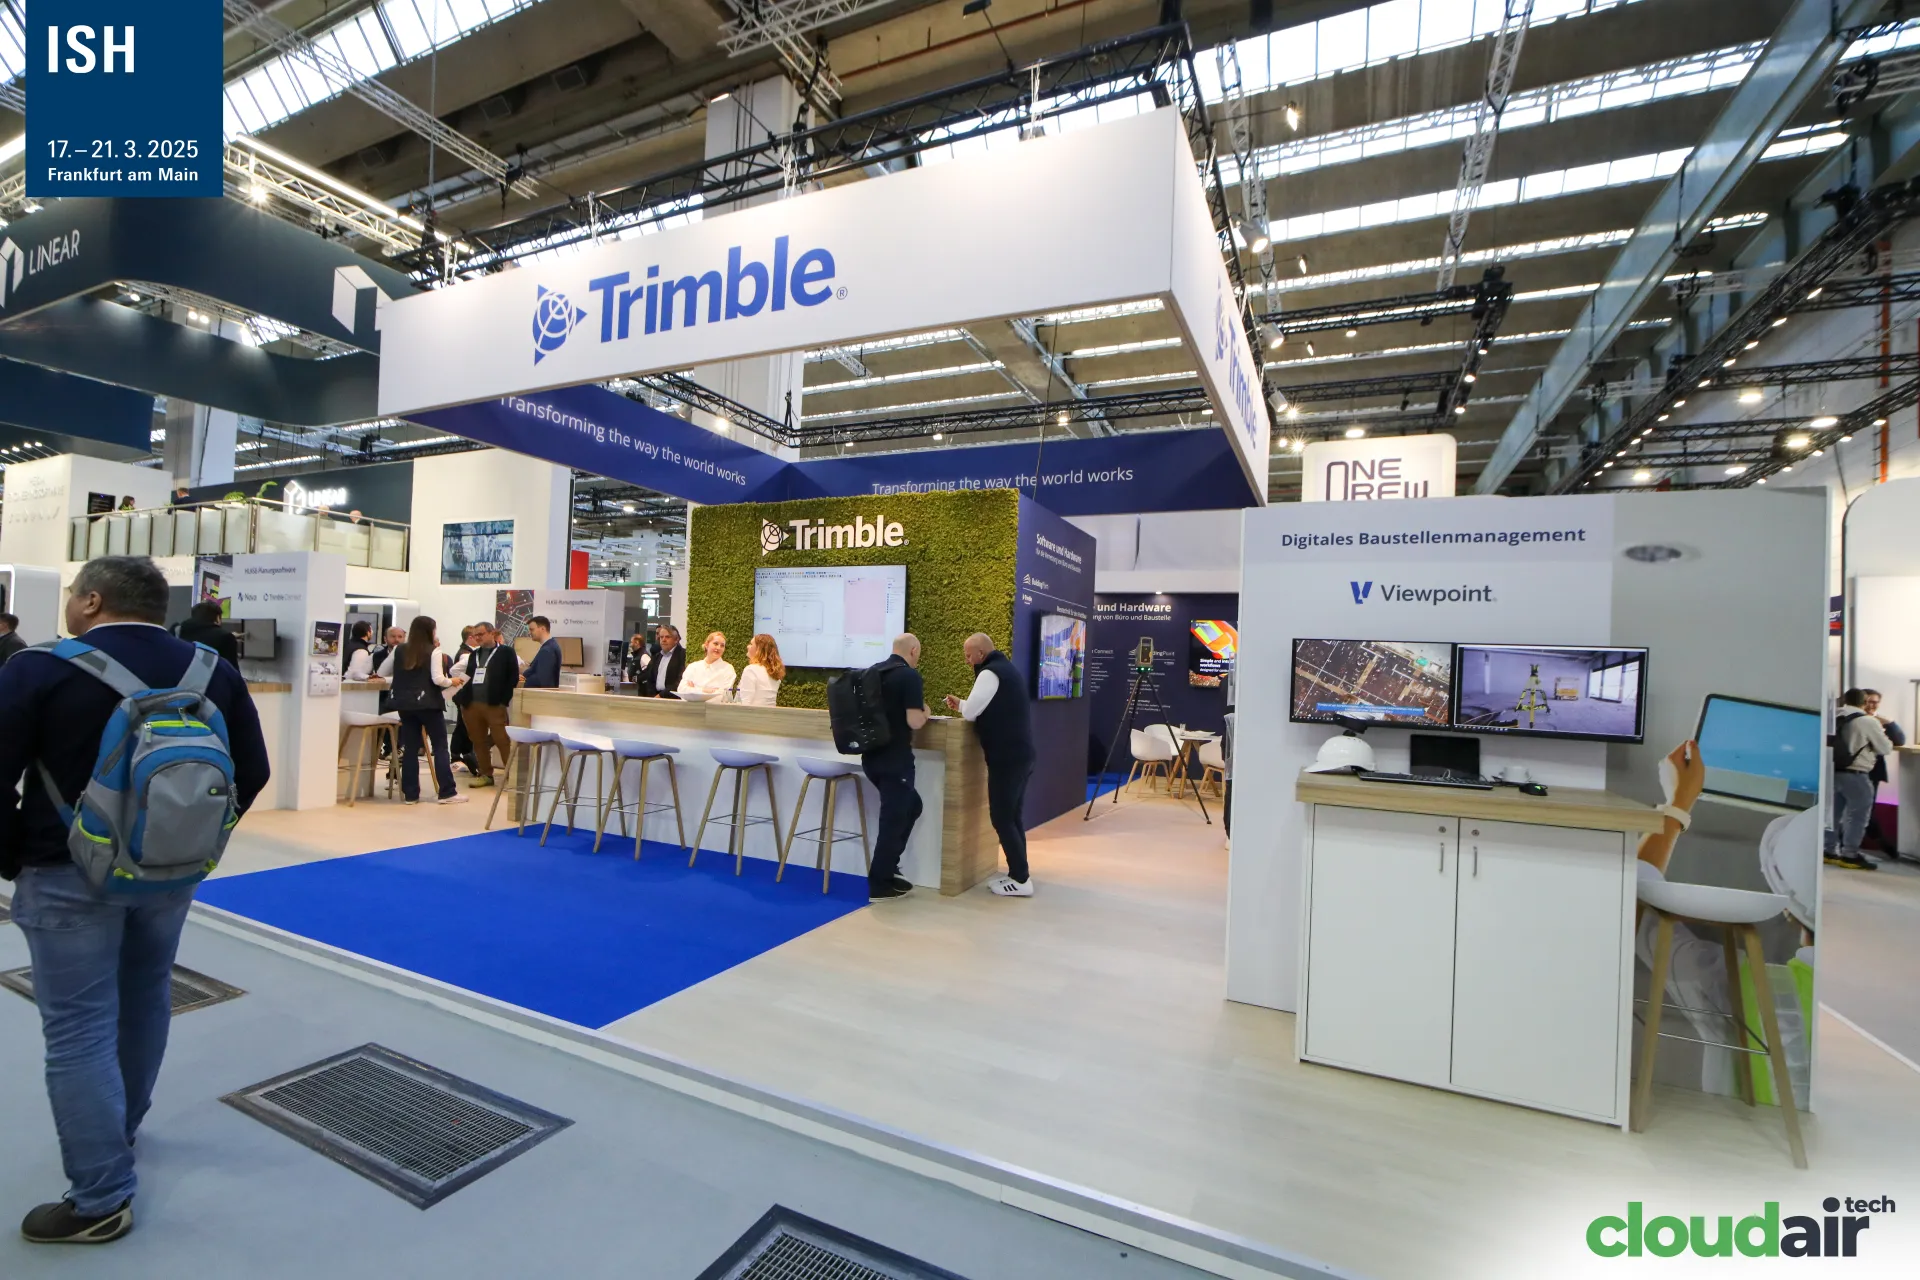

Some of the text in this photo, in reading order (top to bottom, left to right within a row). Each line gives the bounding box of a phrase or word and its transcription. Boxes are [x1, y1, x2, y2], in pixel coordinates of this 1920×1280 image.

[29, 228, 81, 276] LINEAR
[609, 427, 631, 448] the
[633, 437, 659, 460] way
[661, 446, 682, 465] the
[683, 455, 715, 476] world
[716, 465, 747, 487] works
[959, 476, 981, 491] the
[984, 477, 1013, 490] way
[1015, 473, 1038, 487] the
[1042, 469, 1084, 486] world
[1087, 466, 1134, 483] works
[1281, 528, 1586, 550] Digitales Baustellenmanagement
[466, 562, 475, 572] ALL
[1097, 603, 1117, 612] und
[1119, 603, 1172, 612] Hardware
